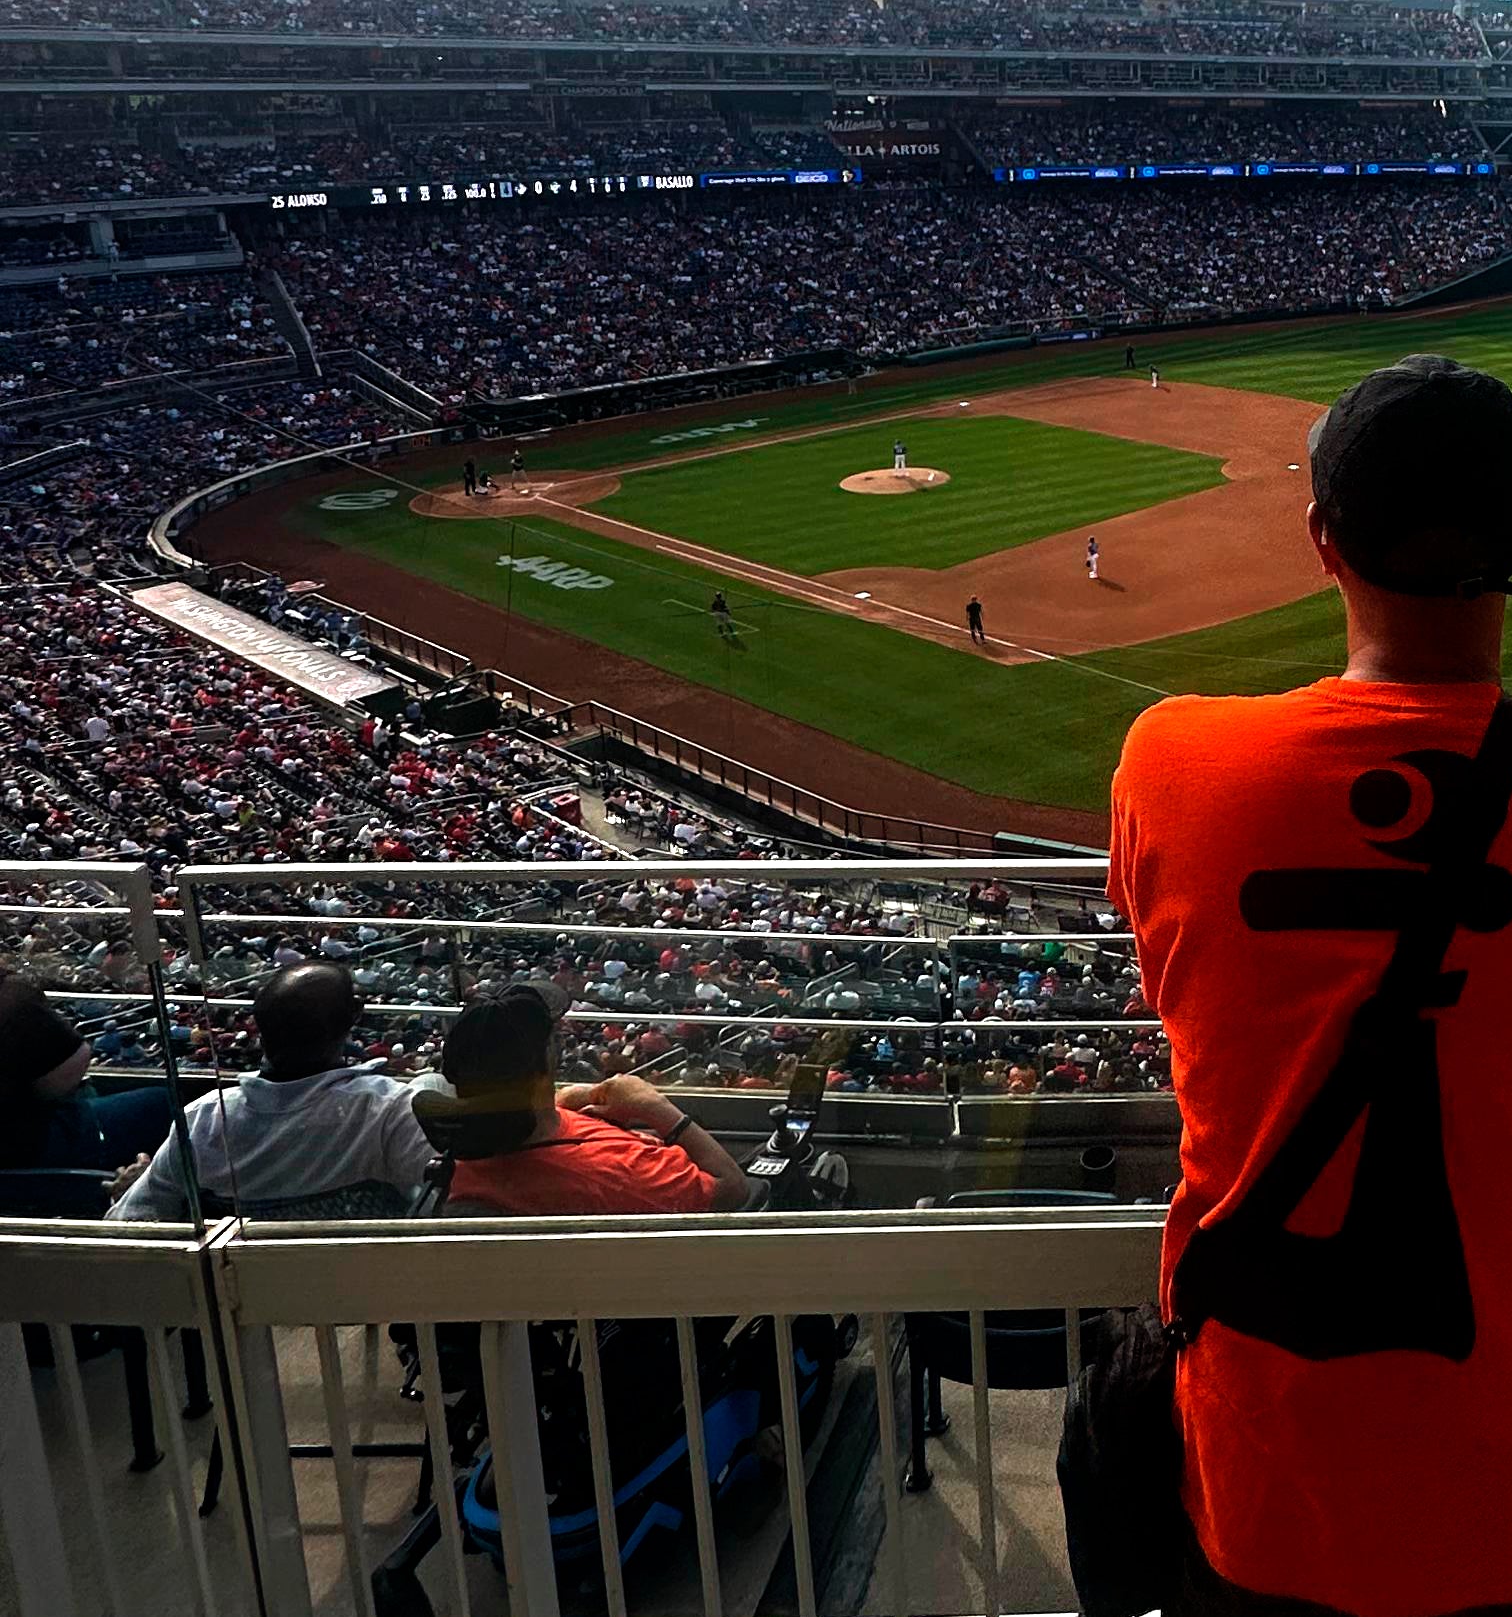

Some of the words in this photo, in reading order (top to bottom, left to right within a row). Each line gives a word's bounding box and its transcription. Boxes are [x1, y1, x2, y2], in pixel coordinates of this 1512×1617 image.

[890, 144, 940, 156] ARTOIS
[656, 176, 693, 189] BASALLO
[272, 196, 284, 208] 25
[287, 194, 327, 207] ALONSO
[255, 637, 347, 682] NATIONALS
